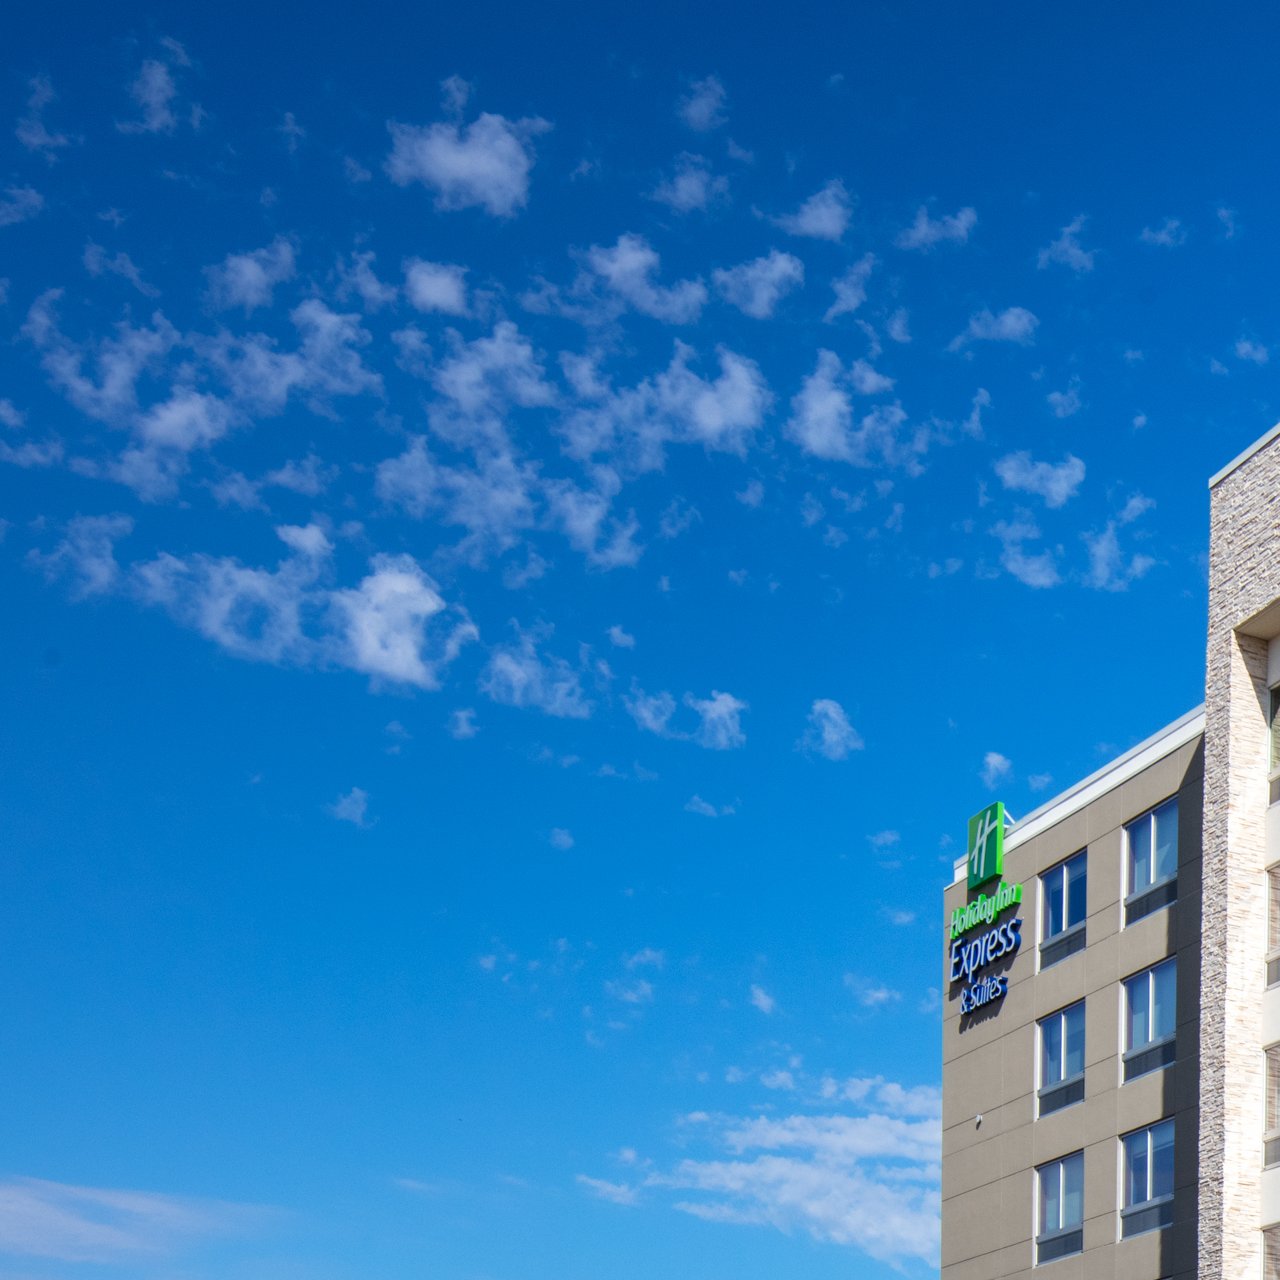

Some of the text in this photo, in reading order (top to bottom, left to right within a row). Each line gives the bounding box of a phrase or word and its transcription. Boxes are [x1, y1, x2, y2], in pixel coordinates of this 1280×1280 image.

[950, 881, 1022, 939] Holiday Inn
[950, 918, 1021, 983] Express
[960, 976, 1007, 1016] & Suites
